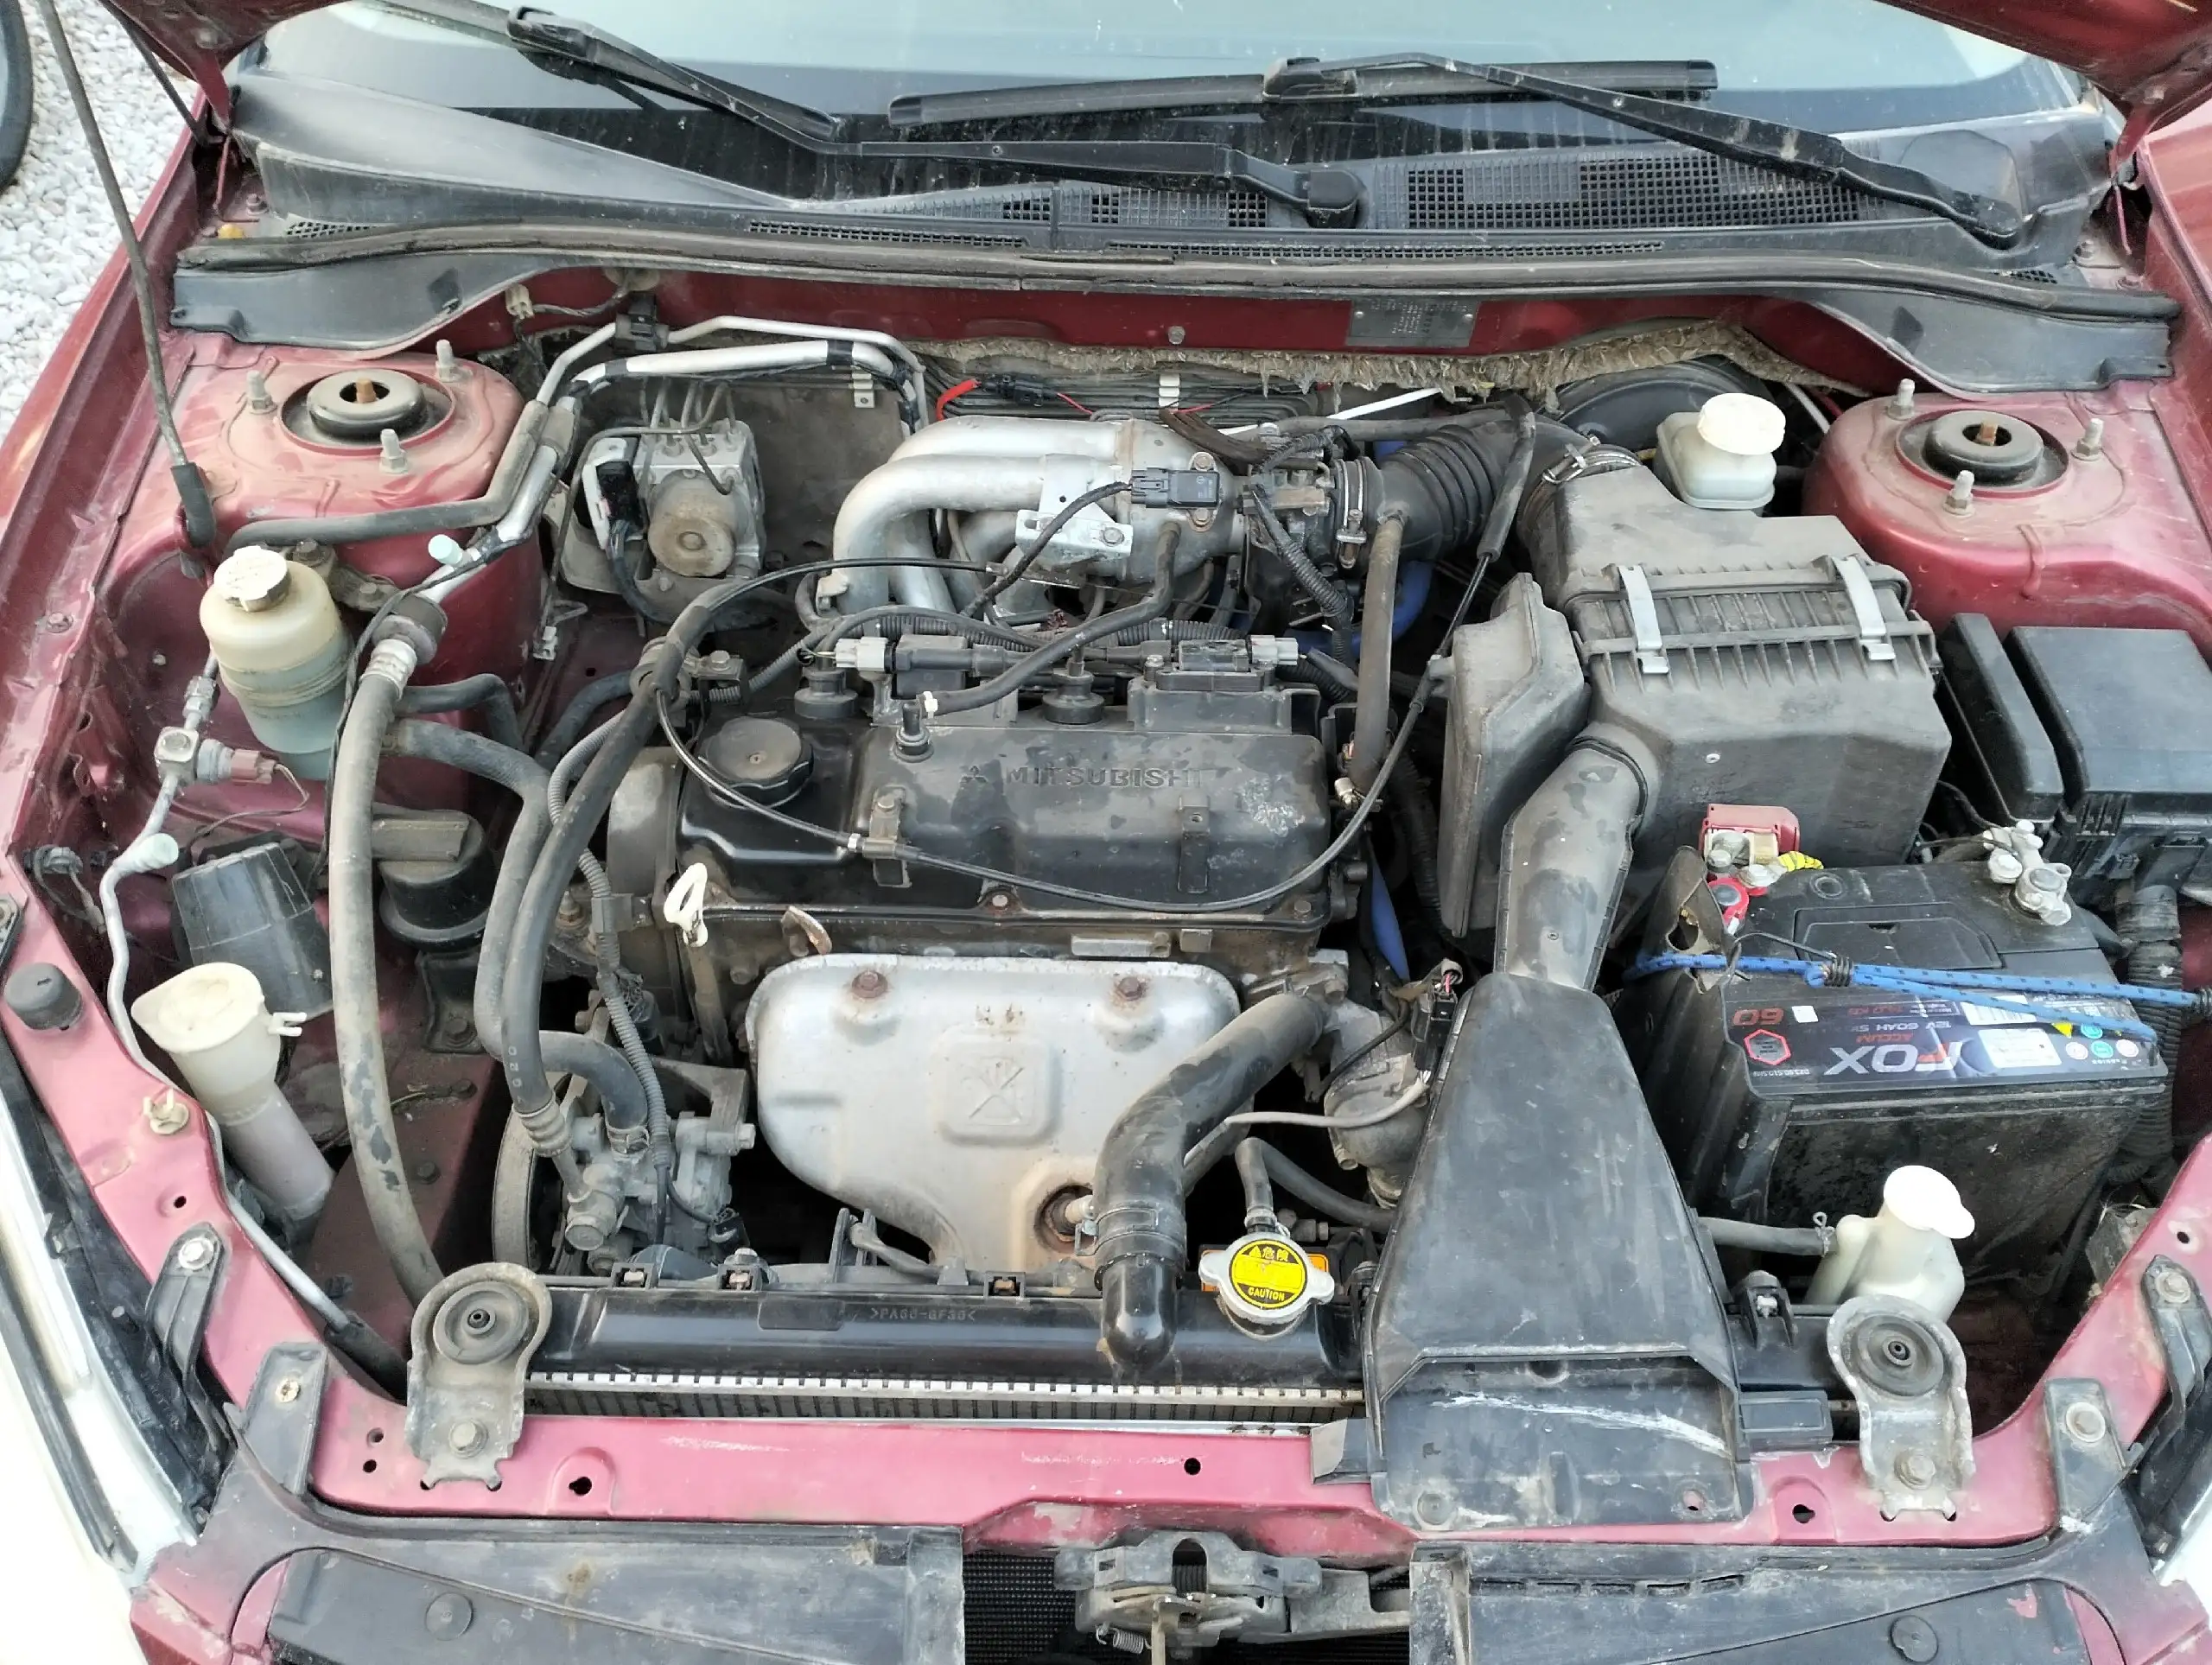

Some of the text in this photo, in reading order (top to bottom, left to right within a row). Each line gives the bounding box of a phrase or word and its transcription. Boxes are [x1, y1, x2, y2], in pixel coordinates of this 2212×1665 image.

[1006, 766, 1202, 788] MITSUBISHI
[1732, 1007, 1784, 1026] 60
[1823, 1043, 1963, 1076] FOX
[1248, 1287, 1285, 1300] CAUTION
